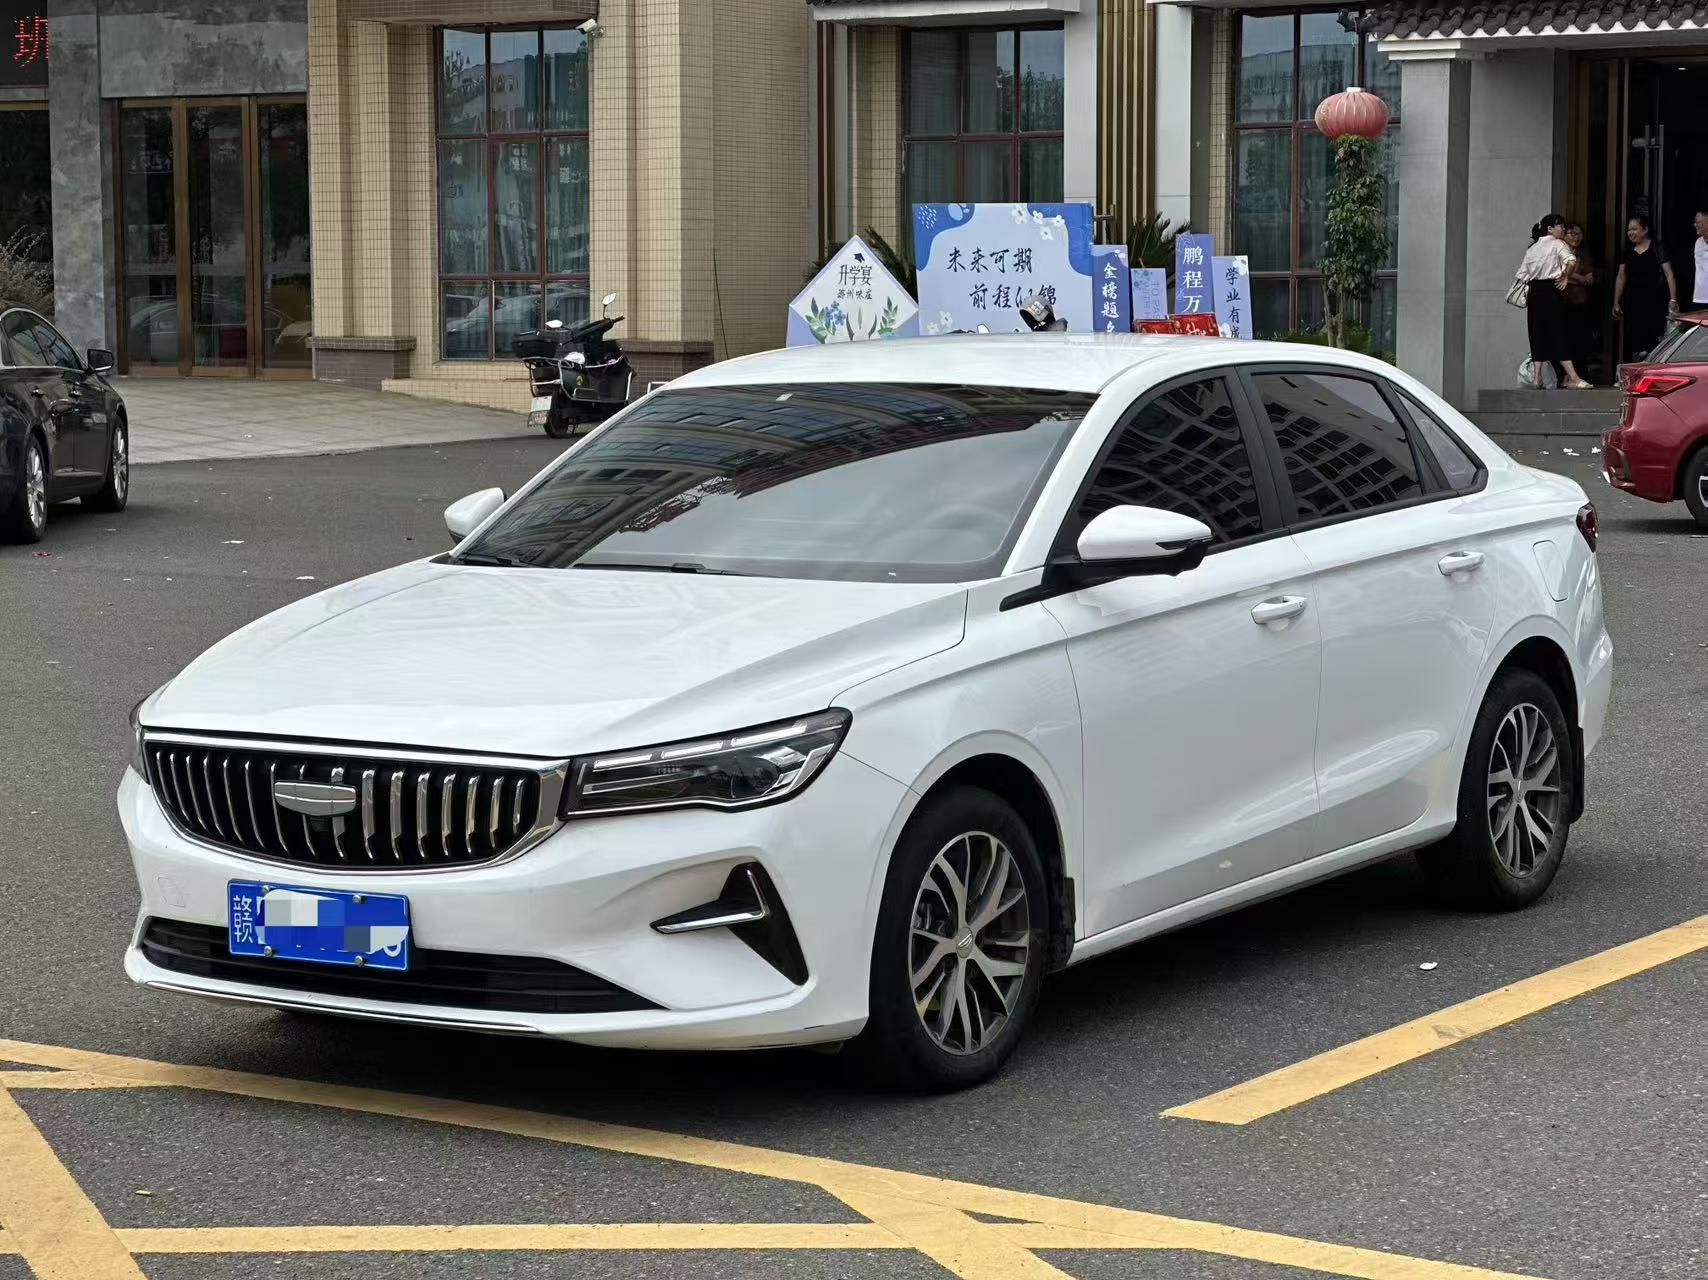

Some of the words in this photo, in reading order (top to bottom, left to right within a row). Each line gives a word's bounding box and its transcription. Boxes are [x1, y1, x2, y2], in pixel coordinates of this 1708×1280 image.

[946, 246, 1033, 274] 未来可期
[838, 264, 873, 286] 升学宴
